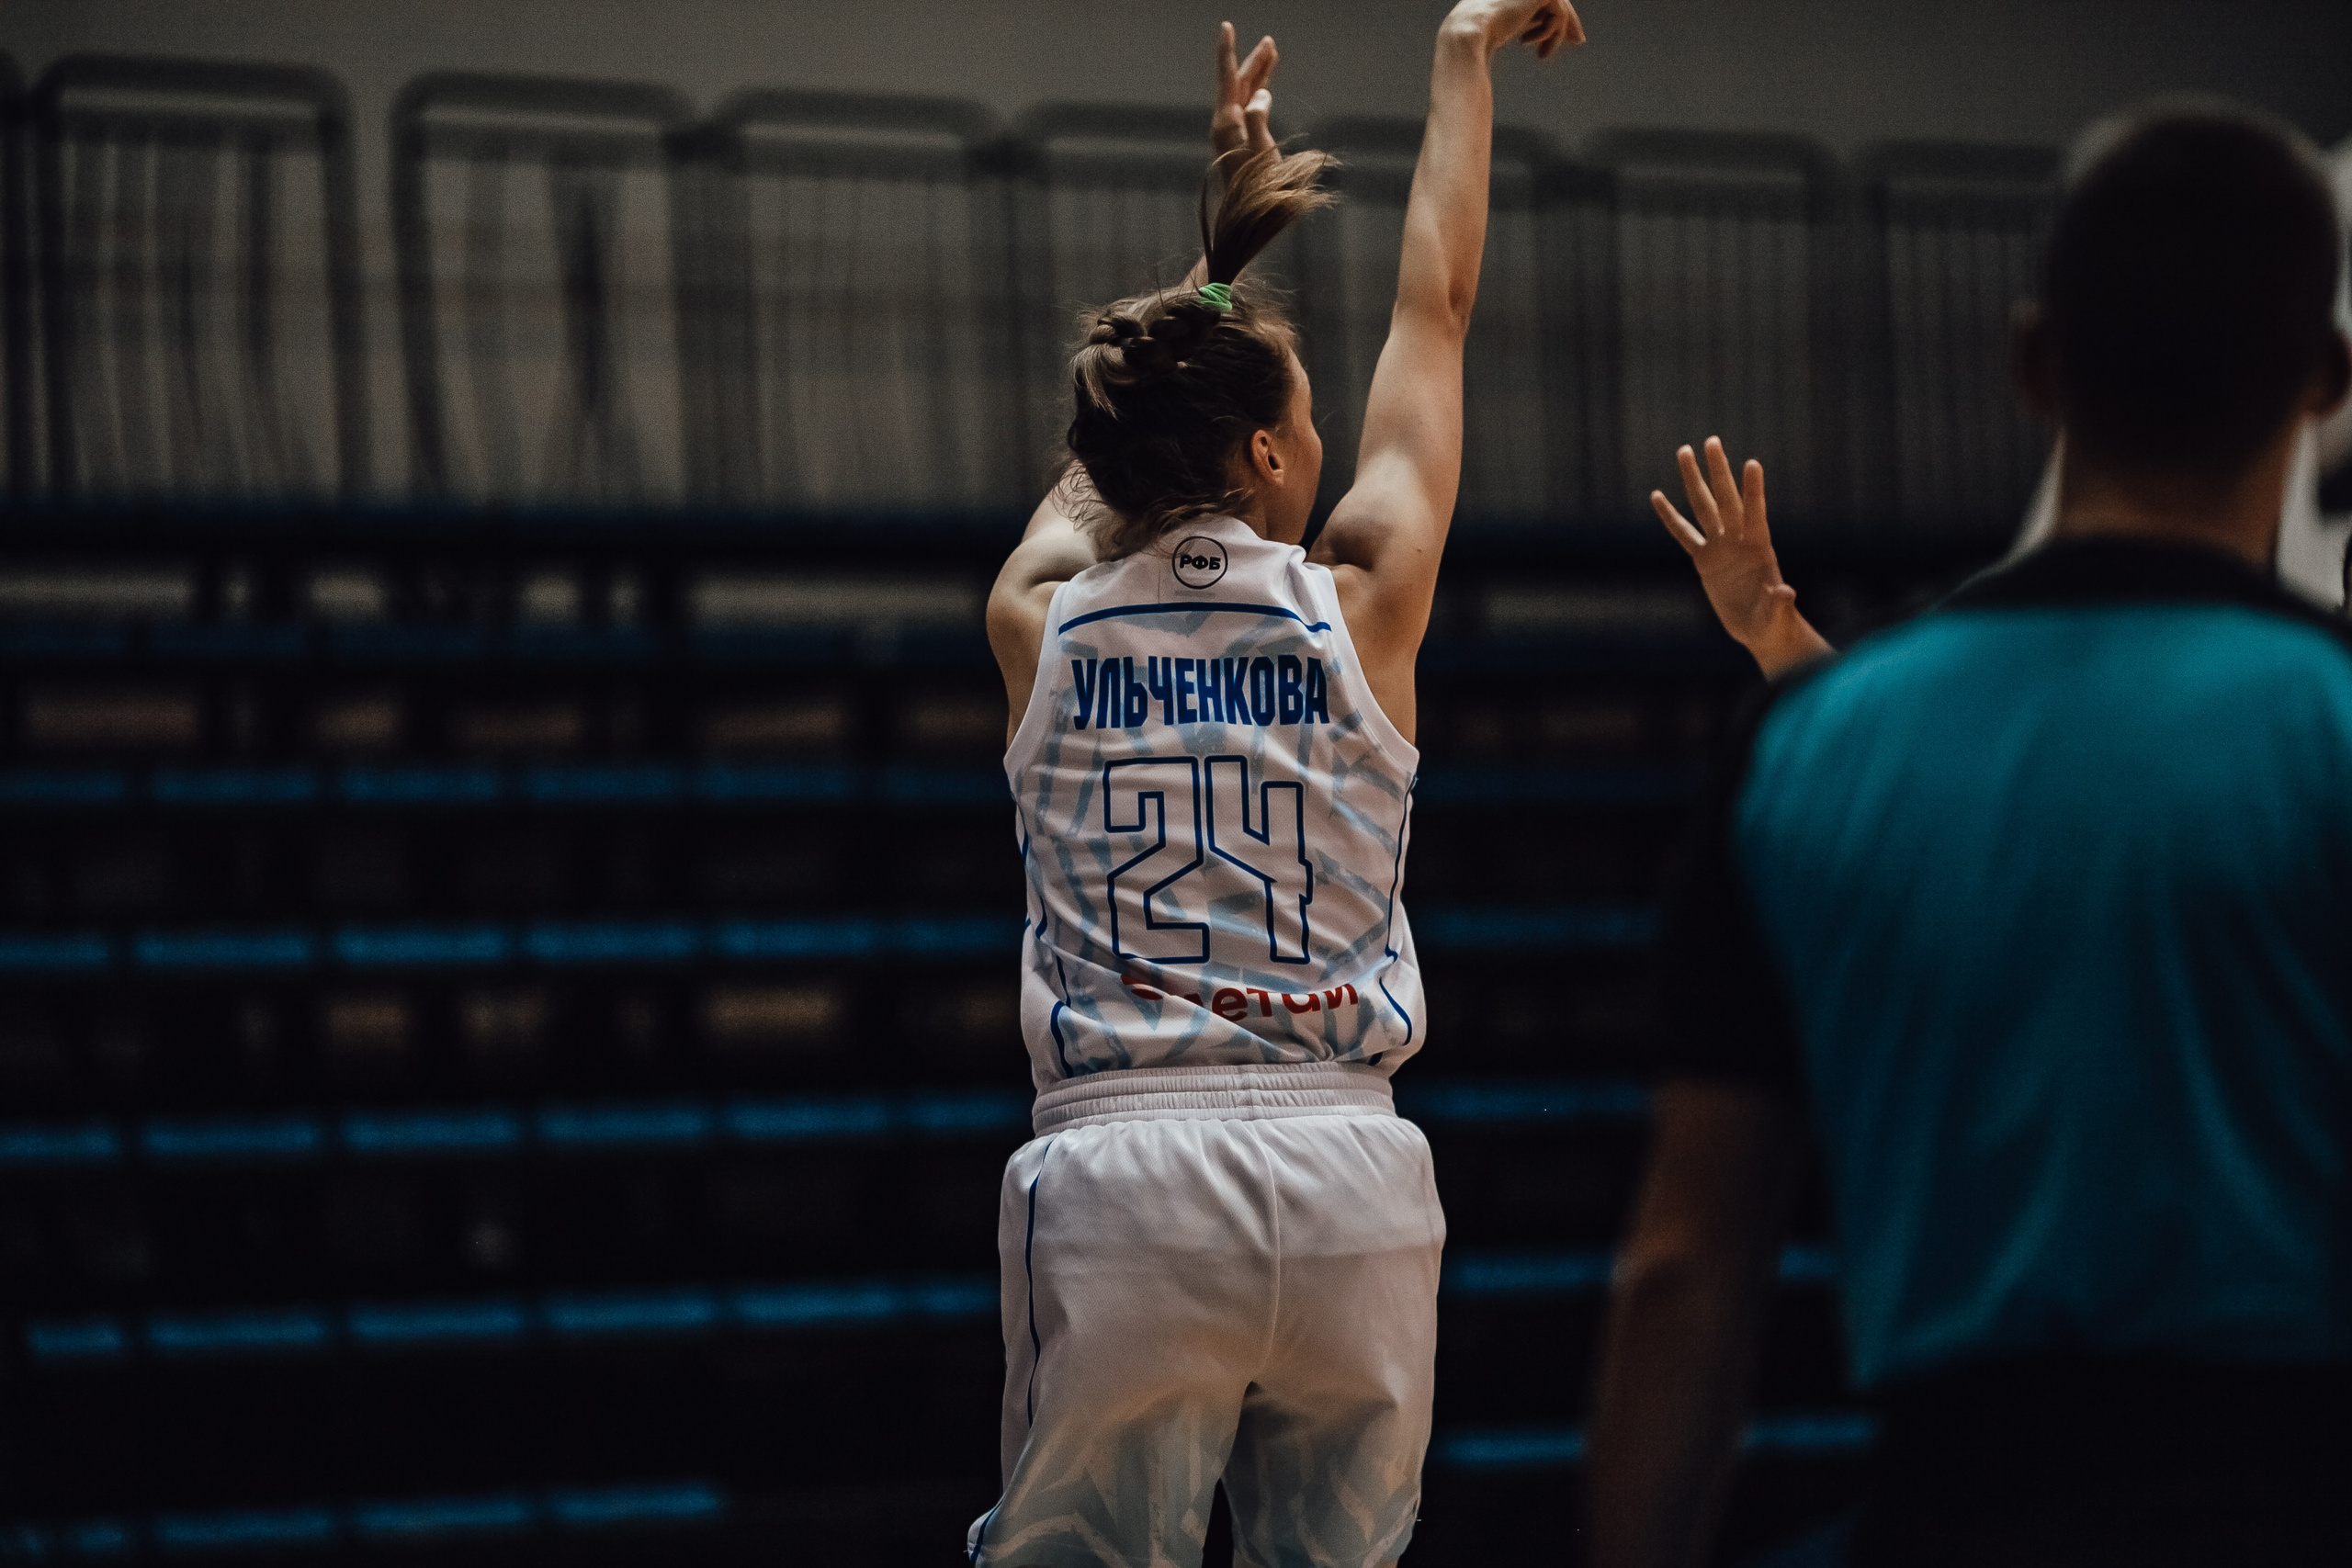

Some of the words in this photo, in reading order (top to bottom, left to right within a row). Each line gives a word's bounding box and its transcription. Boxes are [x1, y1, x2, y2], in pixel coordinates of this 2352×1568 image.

[1179, 554, 1221, 570] РФБ
[1071, 655, 1329, 730] УЛЬЧЕНКОВА
[1102, 755, 1313, 964] 24
